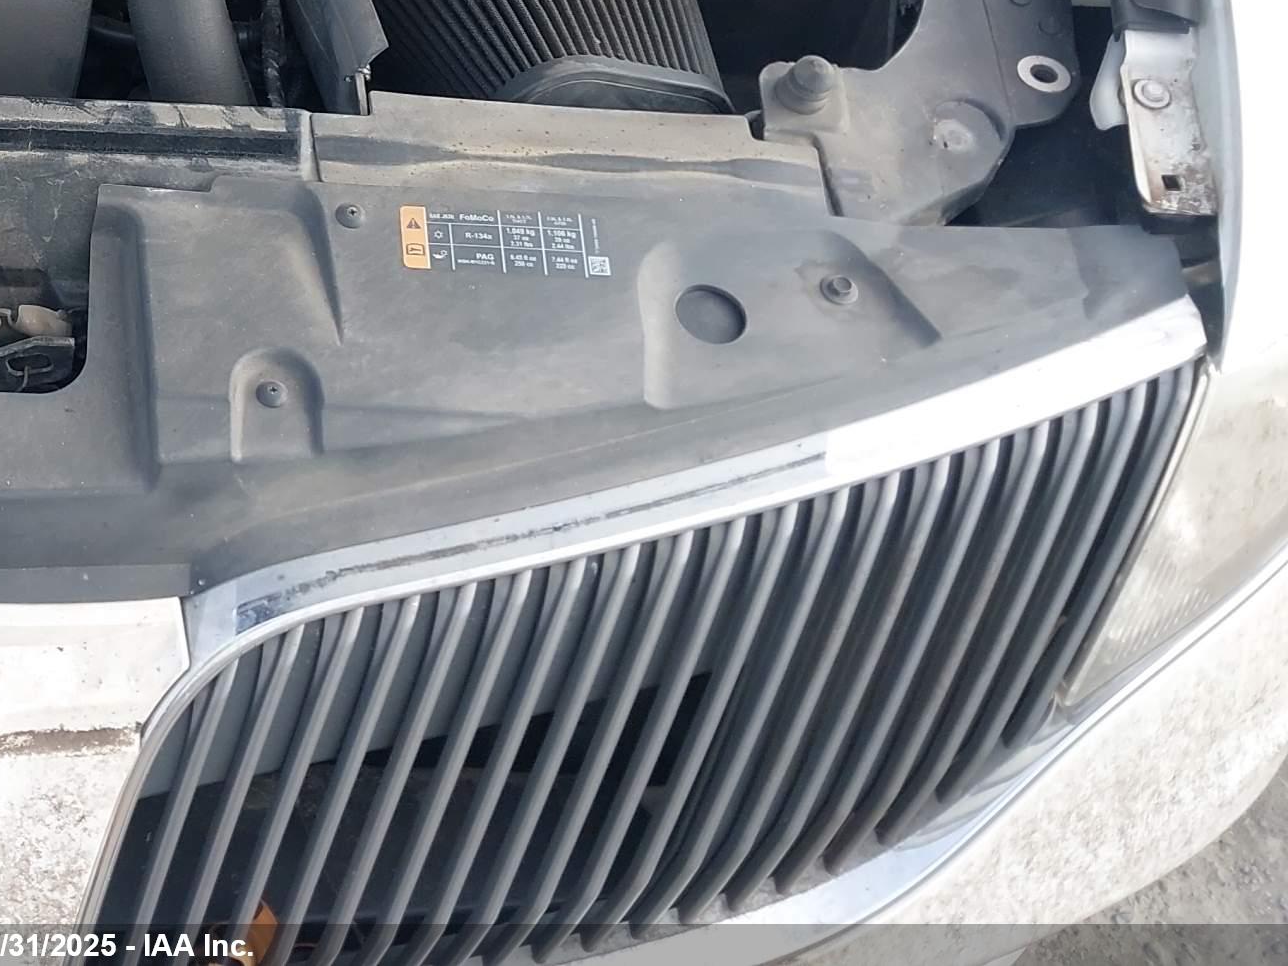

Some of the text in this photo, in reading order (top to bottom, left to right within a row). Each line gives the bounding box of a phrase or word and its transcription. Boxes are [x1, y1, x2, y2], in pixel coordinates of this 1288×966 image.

[459, 213, 495, 222] FoMoCo
[465, 232, 493, 240] R-134a
[475, 252, 495, 261] PAG
